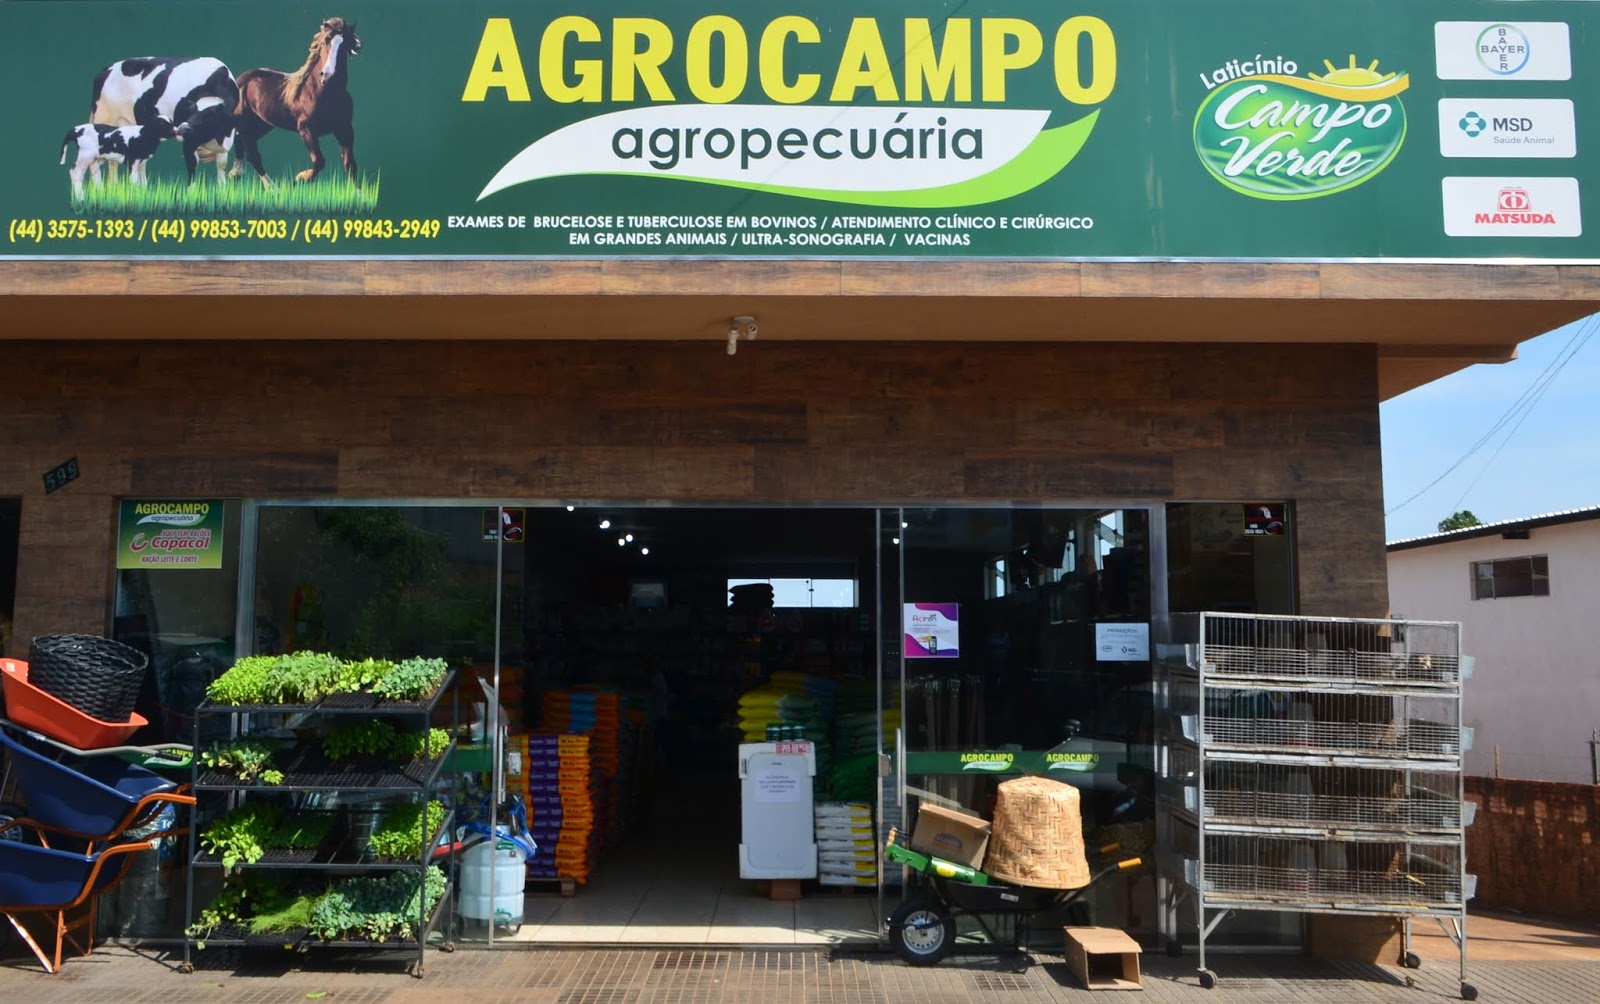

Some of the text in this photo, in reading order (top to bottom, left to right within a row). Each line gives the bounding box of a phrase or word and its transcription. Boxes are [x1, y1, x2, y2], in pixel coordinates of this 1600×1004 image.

[1481, 45, 1525, 54] BAYER
[460, 15, 1117, 104] AGROCAMPO
[1200, 54, 1298, 89] Laticínio
[1214, 84, 1392, 143] Campo
[1493, 117, 1533, 132] MSD
[611, 113, 983, 169] agropecuária
[1493, 136, 1555, 145] Saúde Animal
[1219, 131, 1374, 177] Verde
[447, 213, 1094, 230] EXAMES DE BRUCELOSE E TUBERCULOSE EM BOVINOS / ATENDIMENTO CLÍNICO E CIRÚRGICO
[1474, 213, 1556, 224] MATSUDA
[9, 219, 441, 243] (44) 3575-1393 / (44) 99853-7003 / (44) 99843-2949
[569, 233, 971, 247] EM GRANDES ANIMAIS / ULTRA-SONOGRAFIA / VACINAS
[135, 503, 209, 515] AGROCAMPO
[152, 537, 210, 551] Copacol
[142, 555, 160, 563] RAÇÃO
[961, 753, 1014, 763] AGROCAMPO
[1046, 753, 1100, 763] AGROCAMPO
